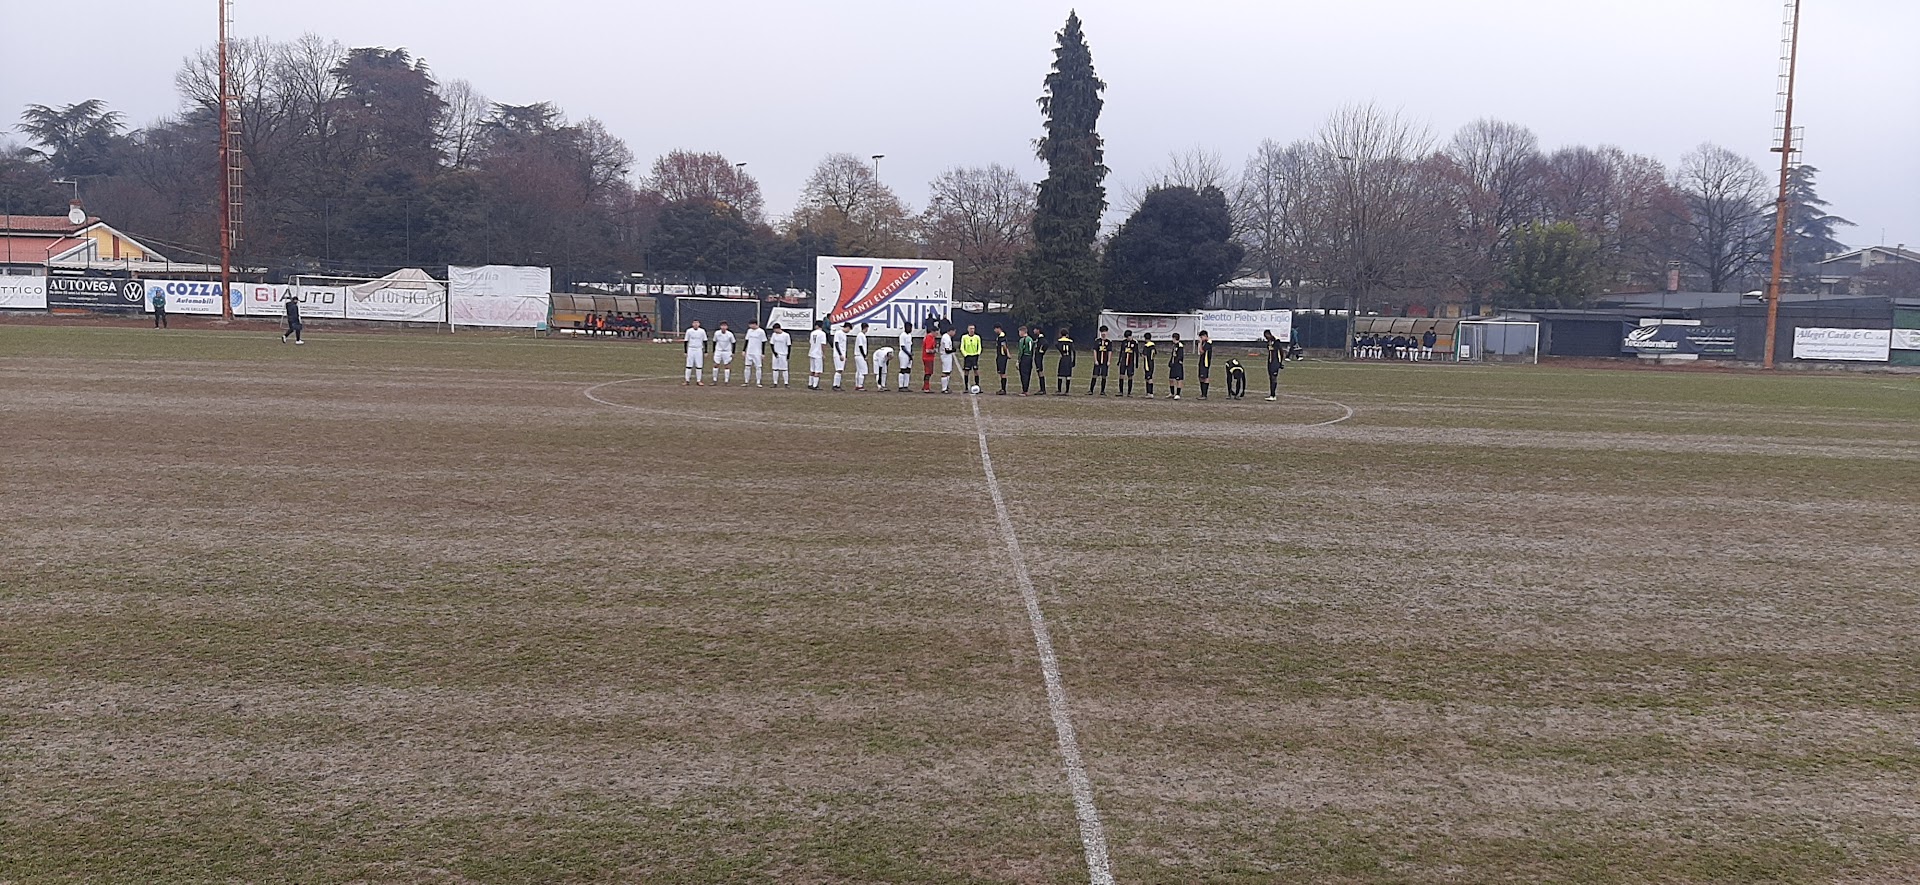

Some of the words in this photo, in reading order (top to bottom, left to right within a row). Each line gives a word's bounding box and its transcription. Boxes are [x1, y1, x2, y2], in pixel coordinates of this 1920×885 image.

[49, 280, 117, 292] AUTOVEGA
[166, 282, 223, 297] COZZA
[176, 297, 214, 305] Automobili
[832, 298, 874, 323] IMPIANTI
[874, 270, 913, 302] ELETTRICI
